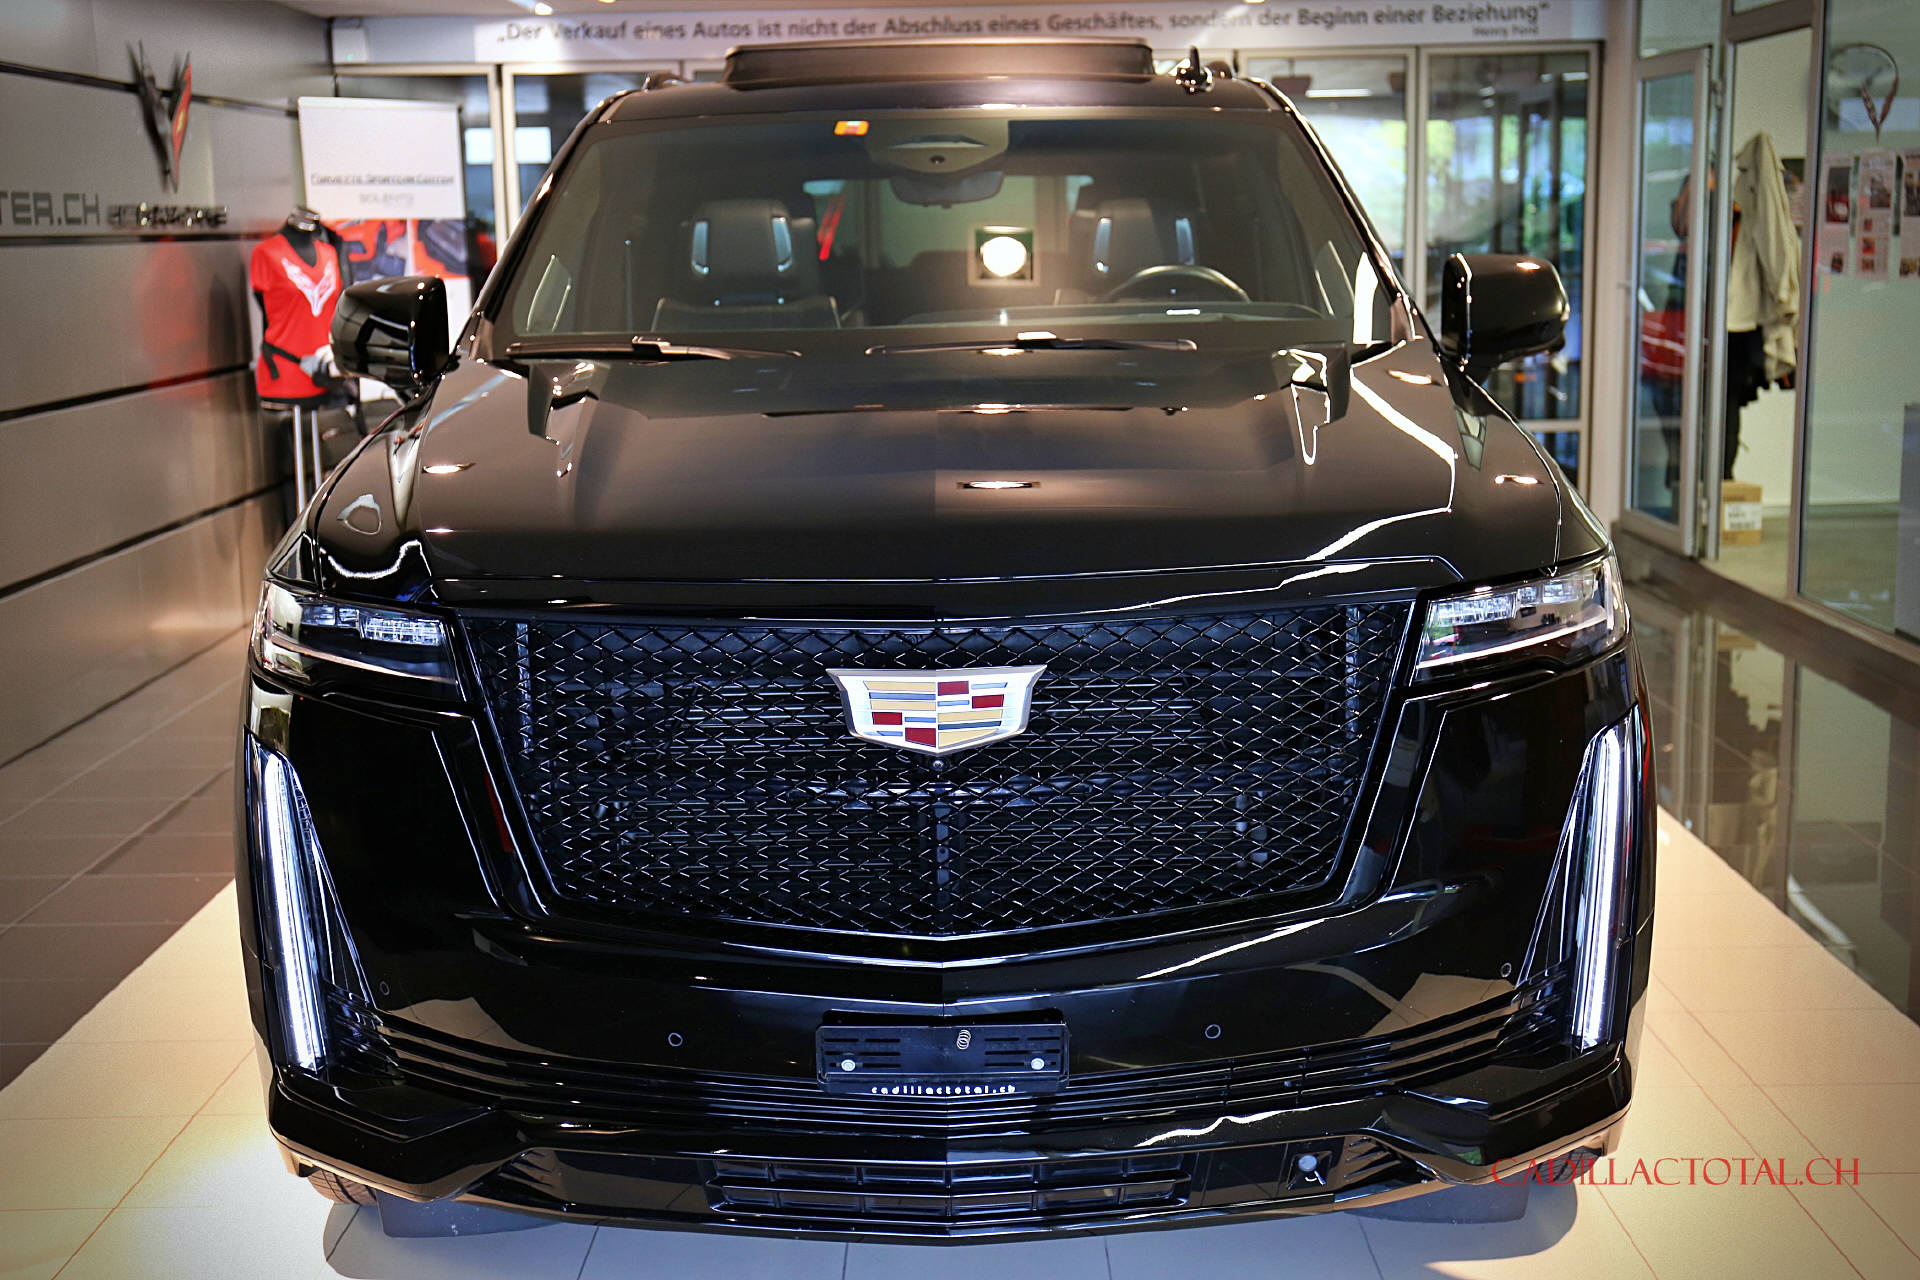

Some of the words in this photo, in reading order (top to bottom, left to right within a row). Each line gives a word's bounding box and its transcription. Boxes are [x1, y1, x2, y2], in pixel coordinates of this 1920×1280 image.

[632, 20, 687, 39] eines
[692, 20, 753, 38] Autos
[757, 18, 782, 37] ist
[787, 17, 838, 36] nicht
[843, 16, 877, 35] der
[884, 15, 983, 34] Abschluss
[988, 14, 1041, 32] eines
[1046, 11, 1163, 32] Geschäftes,
[1168, 9, 1252, 29] sondrn
[1256, 6, 1293, 26] der
[1297, 6, 1369, 31] Beginn
[1374, 5, 1427, 24] einer
[871, 1084, 1016, 1095] cadillactotal.ch
